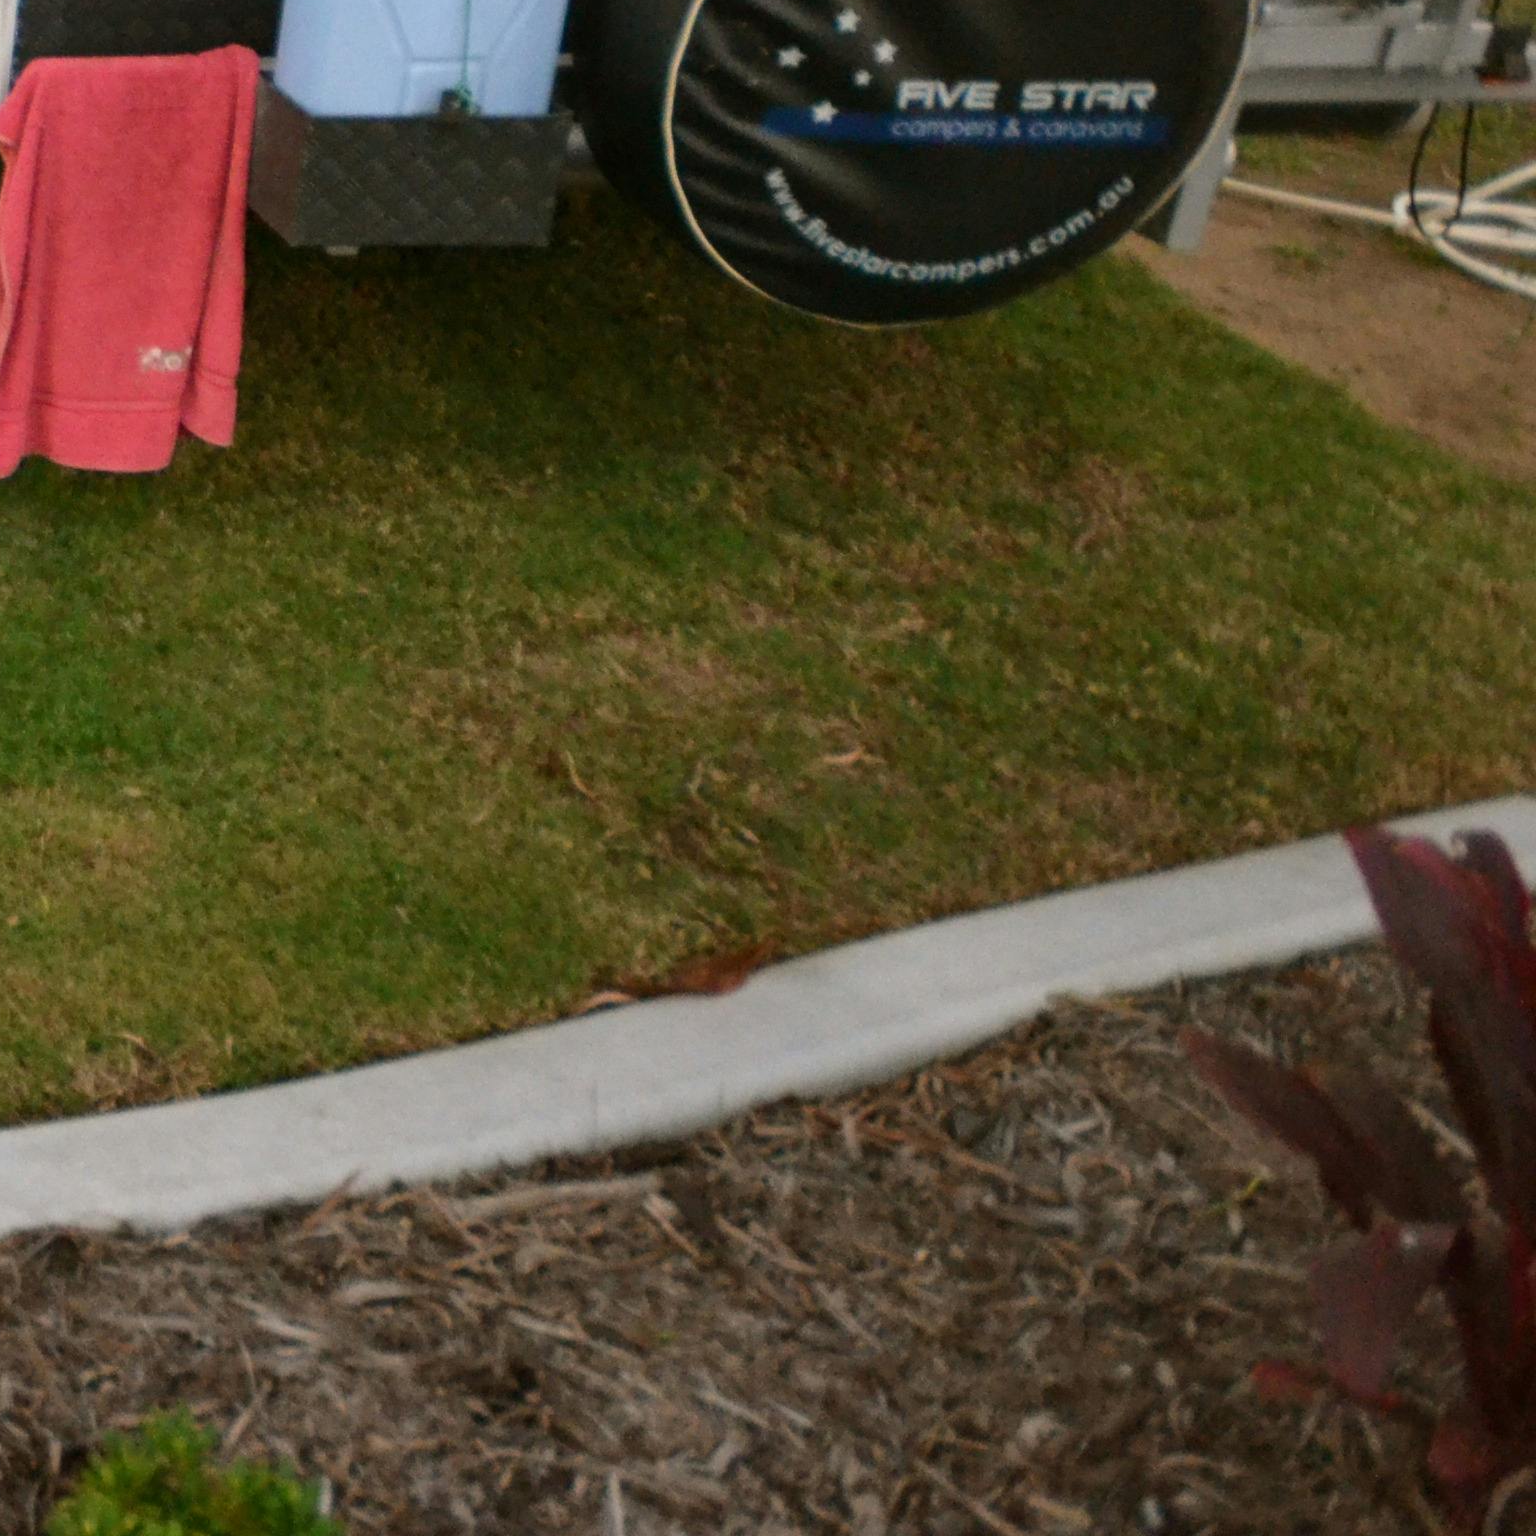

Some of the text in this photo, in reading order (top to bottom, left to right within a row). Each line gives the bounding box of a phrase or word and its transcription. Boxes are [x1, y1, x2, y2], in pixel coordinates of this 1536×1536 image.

[897, 79, 1156, 110] FIVE STAR
[890, 118, 1144, 140] campers & caravans
